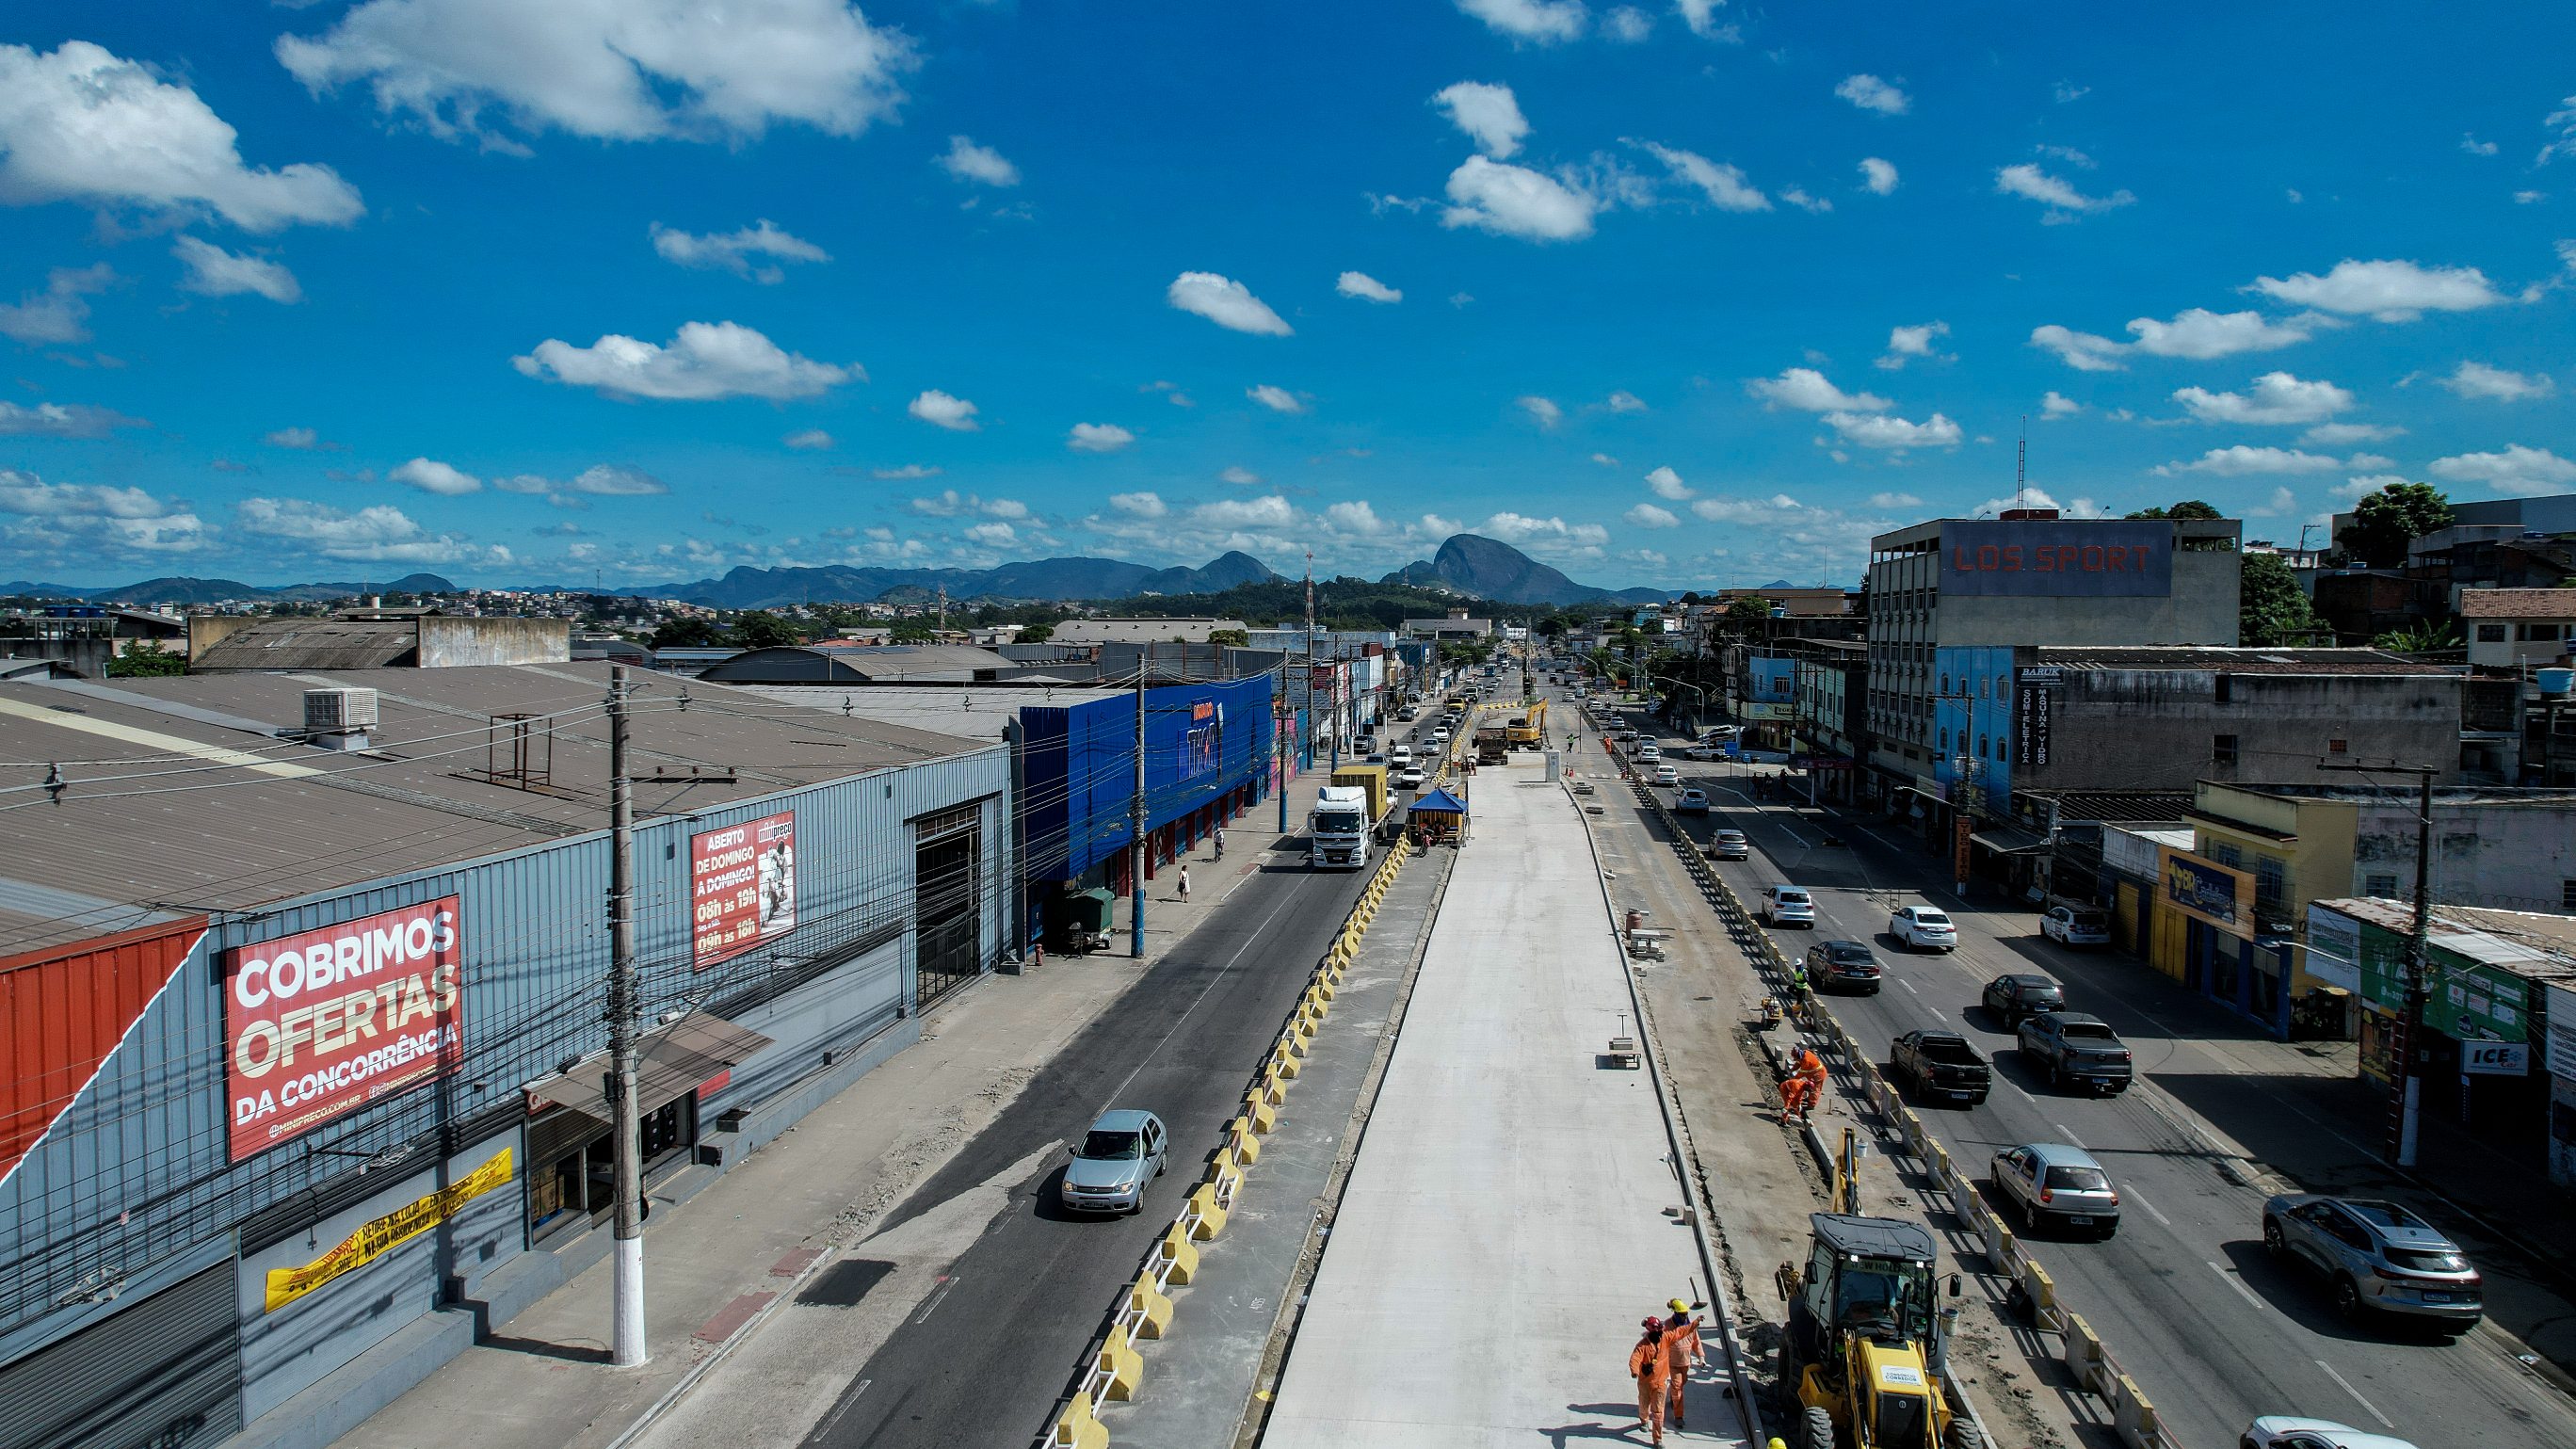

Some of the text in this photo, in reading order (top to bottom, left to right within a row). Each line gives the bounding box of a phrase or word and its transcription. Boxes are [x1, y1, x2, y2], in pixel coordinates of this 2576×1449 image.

[1955, 545, 2151, 572] LOS SPORT
[2021, 668, 2061, 676] BARUK
[2022, 689, 2031, 710] SOM
[2037, 736, 2046, 765] VIDRO
[707, 829, 745, 851] ABERTO
[759, 822, 792, 842] minipreço
[696, 845, 754, 876] DE DOMINGO
[697, 865, 755, 897] A DOMINGO!
[697, 886, 757, 923] 08h às 19h
[724, 929, 734, 943] às
[235, 910, 455, 1008] COBRIMOS
[235, 964, 458, 1079] OFERTAS
[2473, 1048, 2510, 1064] ICE
[236, 1088, 278, 1126] DA
